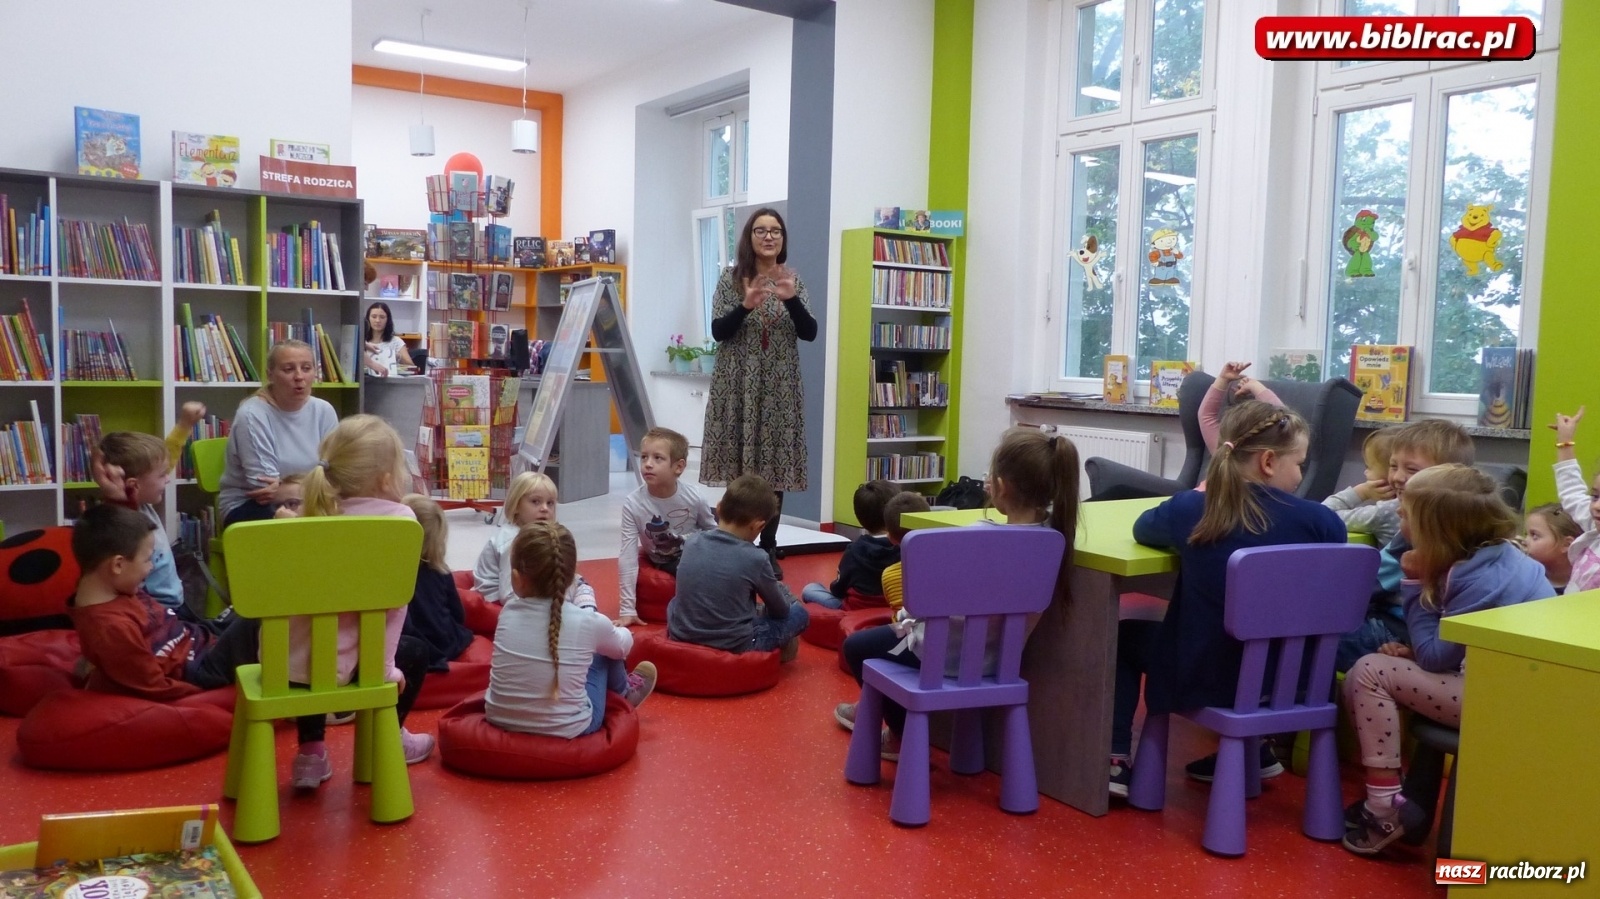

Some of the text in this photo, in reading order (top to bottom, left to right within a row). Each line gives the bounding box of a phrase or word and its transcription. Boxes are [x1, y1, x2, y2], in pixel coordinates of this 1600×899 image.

[262, 170, 354, 189] STREFA RODZICA
[515, 239, 541, 252] RELIC
